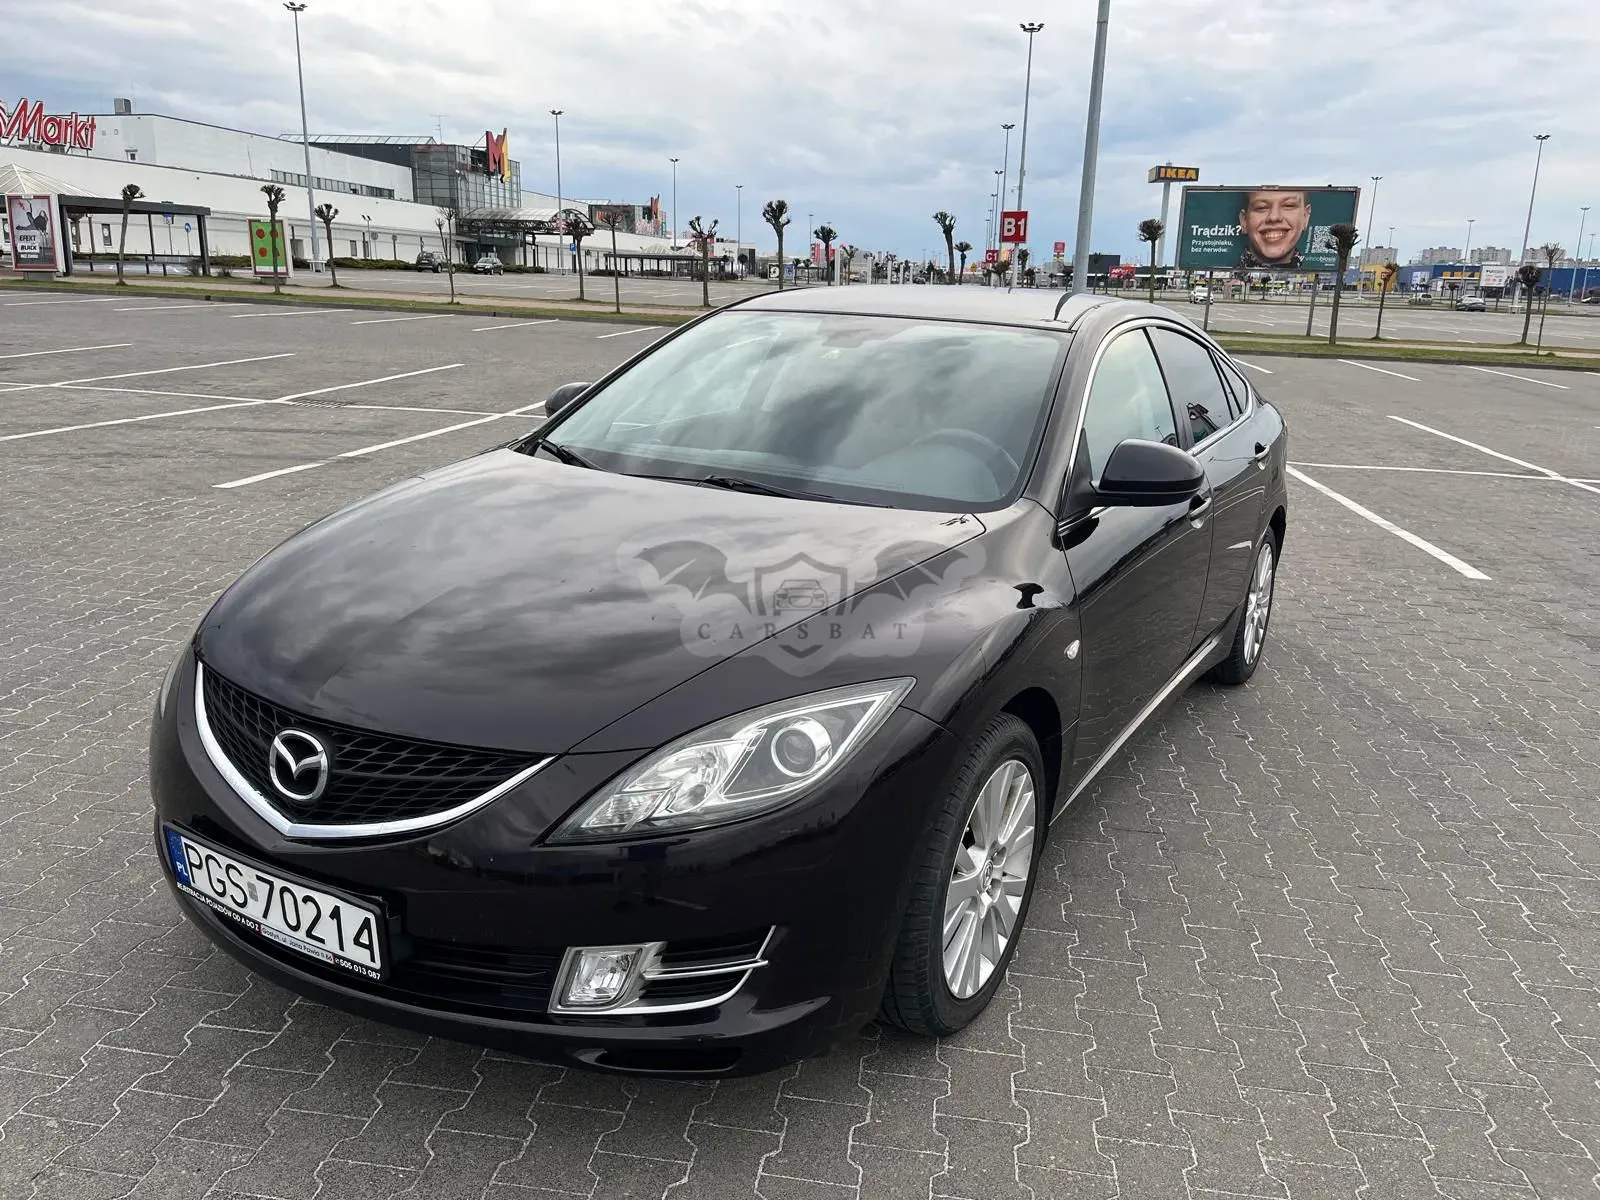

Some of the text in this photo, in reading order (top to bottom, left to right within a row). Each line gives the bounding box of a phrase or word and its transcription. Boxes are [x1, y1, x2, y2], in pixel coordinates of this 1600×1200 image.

[2, 97, 97, 151] Markt
[1159, 167, 1197, 180] IKEA
[1003, 217, 1026, 237] B1
[1190, 224, 1243, 238] Trądzik?
[986, 252, 998, 262] C1
[175, 860, 189, 877] PL
[183, 841, 378, 964] PGS 70214
[232, 912, 241, 922] OD
[246, 919, 255, 929] DO
[339, 959, 353, 970] 505
[353, 964, 367, 975] 013
[367, 969, 381, 980] 087
